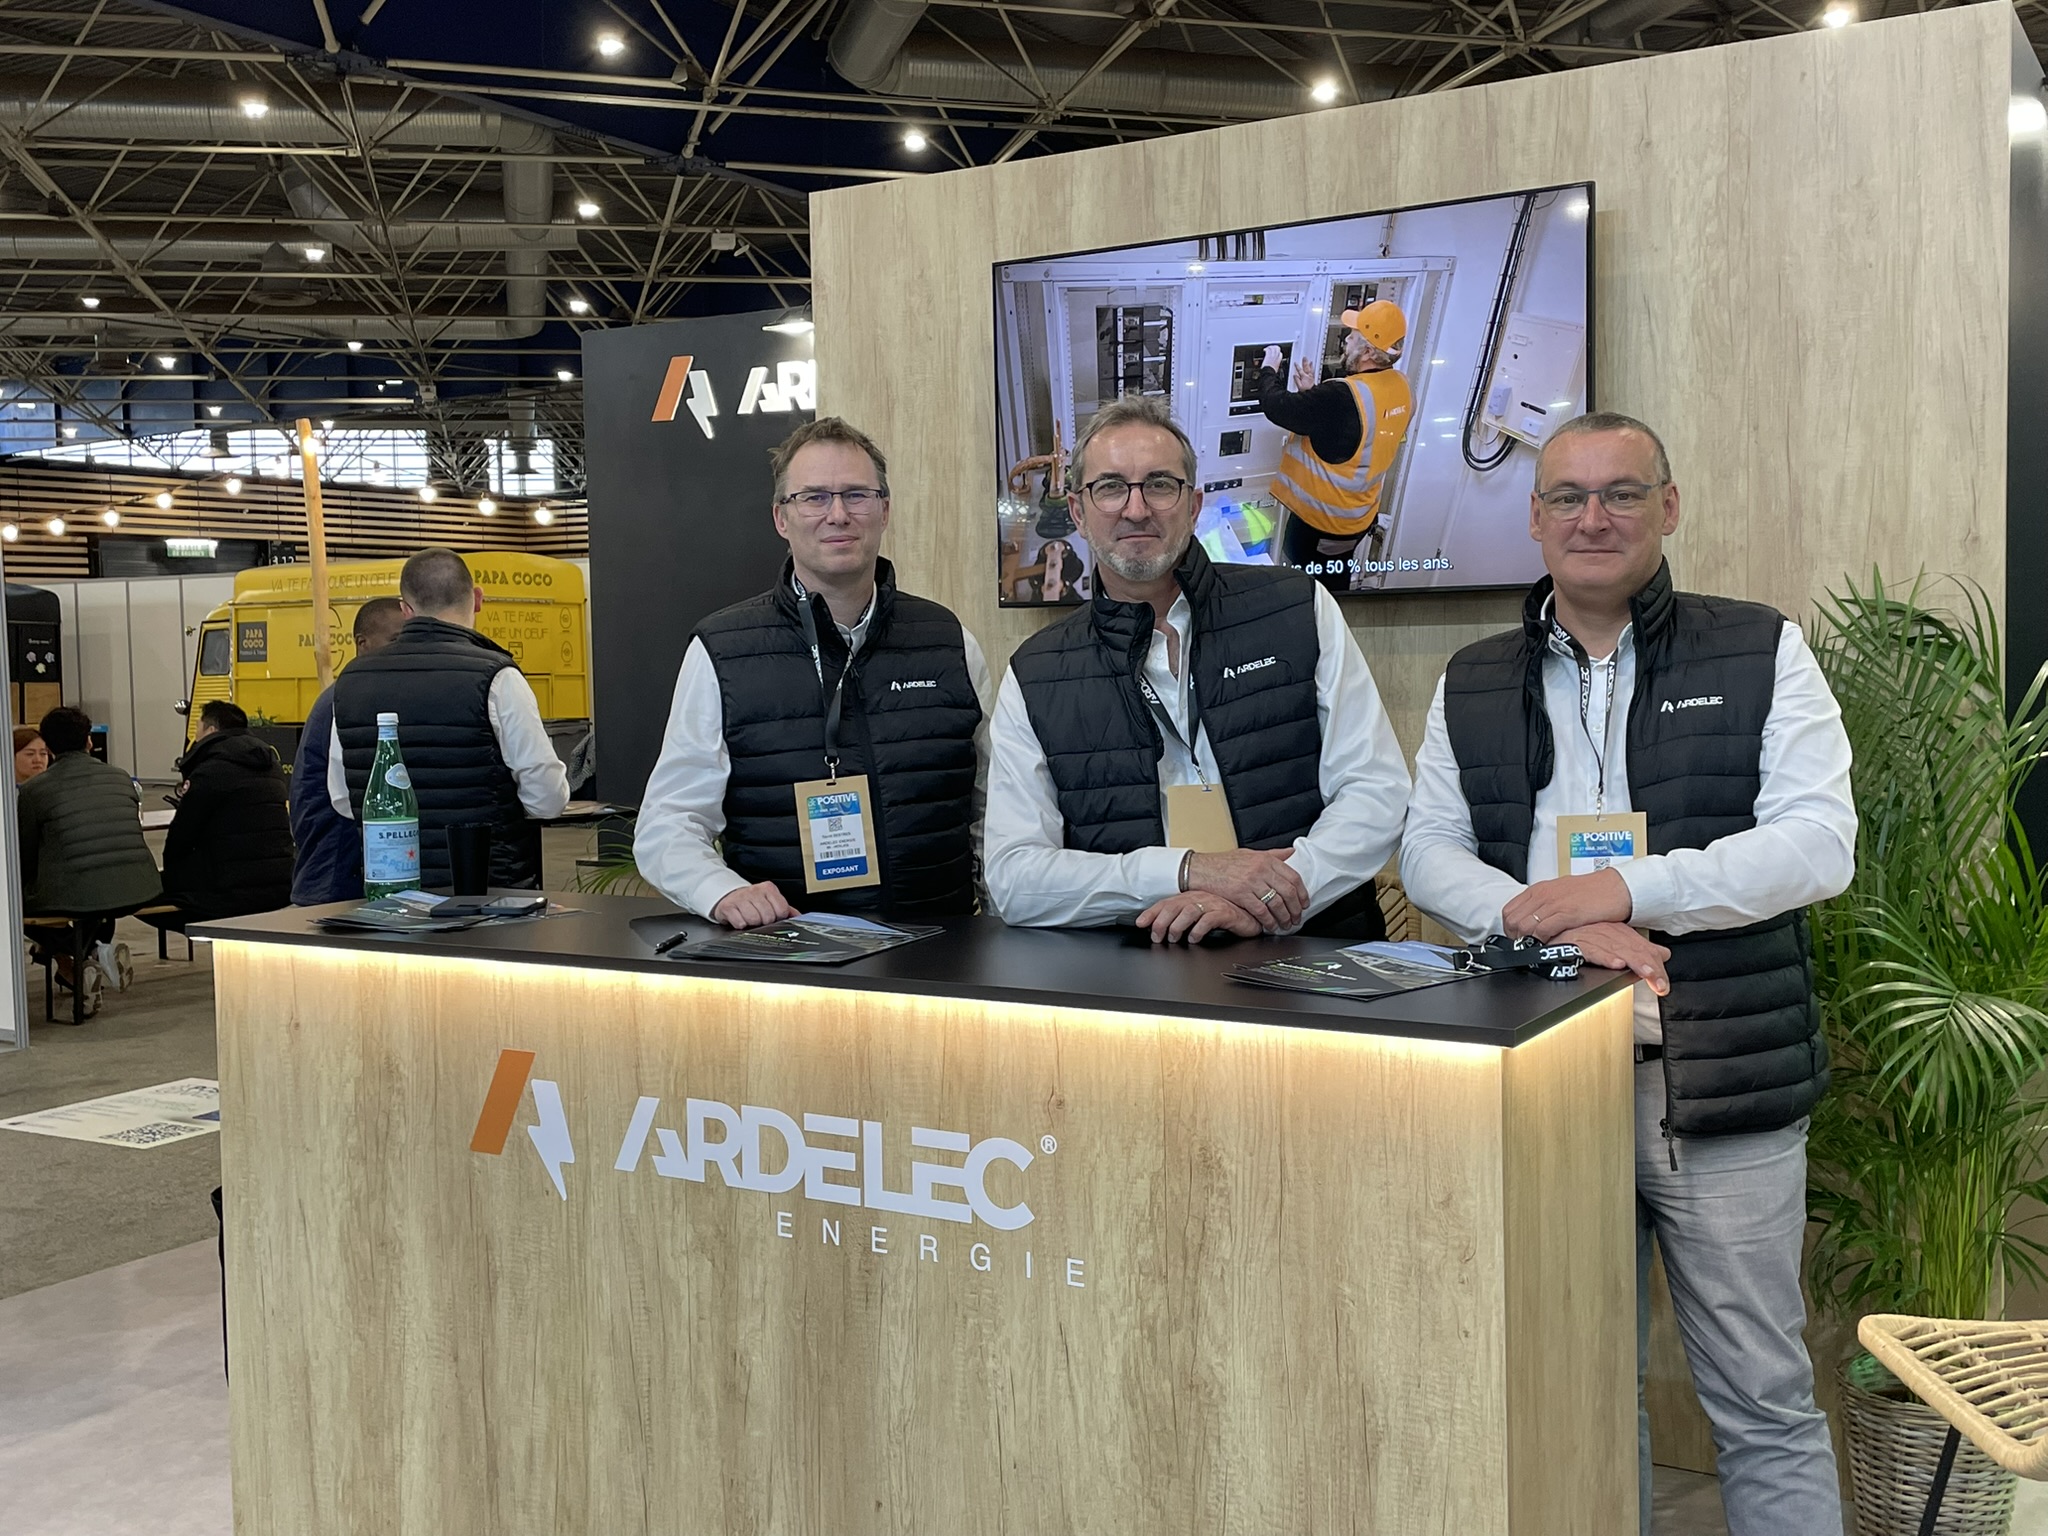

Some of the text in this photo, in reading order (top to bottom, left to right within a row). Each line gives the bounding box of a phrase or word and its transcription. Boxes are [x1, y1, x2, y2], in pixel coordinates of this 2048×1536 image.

[737, 359, 816, 414] AR
[1305, 562, 1323, 575] de
[1326, 560, 1344, 574] 50
[1347, 559, 1361, 573] %
[1365, 559, 1394, 573] tous
[1399, 557, 1419, 571] les
[1423, 558, 1454, 570] ans.
[475, 570, 553, 587] PAPA COCO
[271, 579, 283, 592] VA
[486, 611, 500, 622] VA
[503, 611, 516, 623] TE
[245, 629, 263, 639] PAPA
[330, 633, 353, 646] COC
[508, 628, 522, 640] UN
[242, 639, 264, 649] COCO
[1236, 656, 1277, 675] ARDELEC
[1676, 696, 1724, 710] ARDELEC
[817, 792, 858, 806] POSITIVE
[1583, 831, 1632, 842] POSITIVE
[822, 865, 859, 876] EXPOSANT
[614, 1096, 1035, 1231] ARDELEC
[776, 1211, 1086, 1289] ENERGIE
